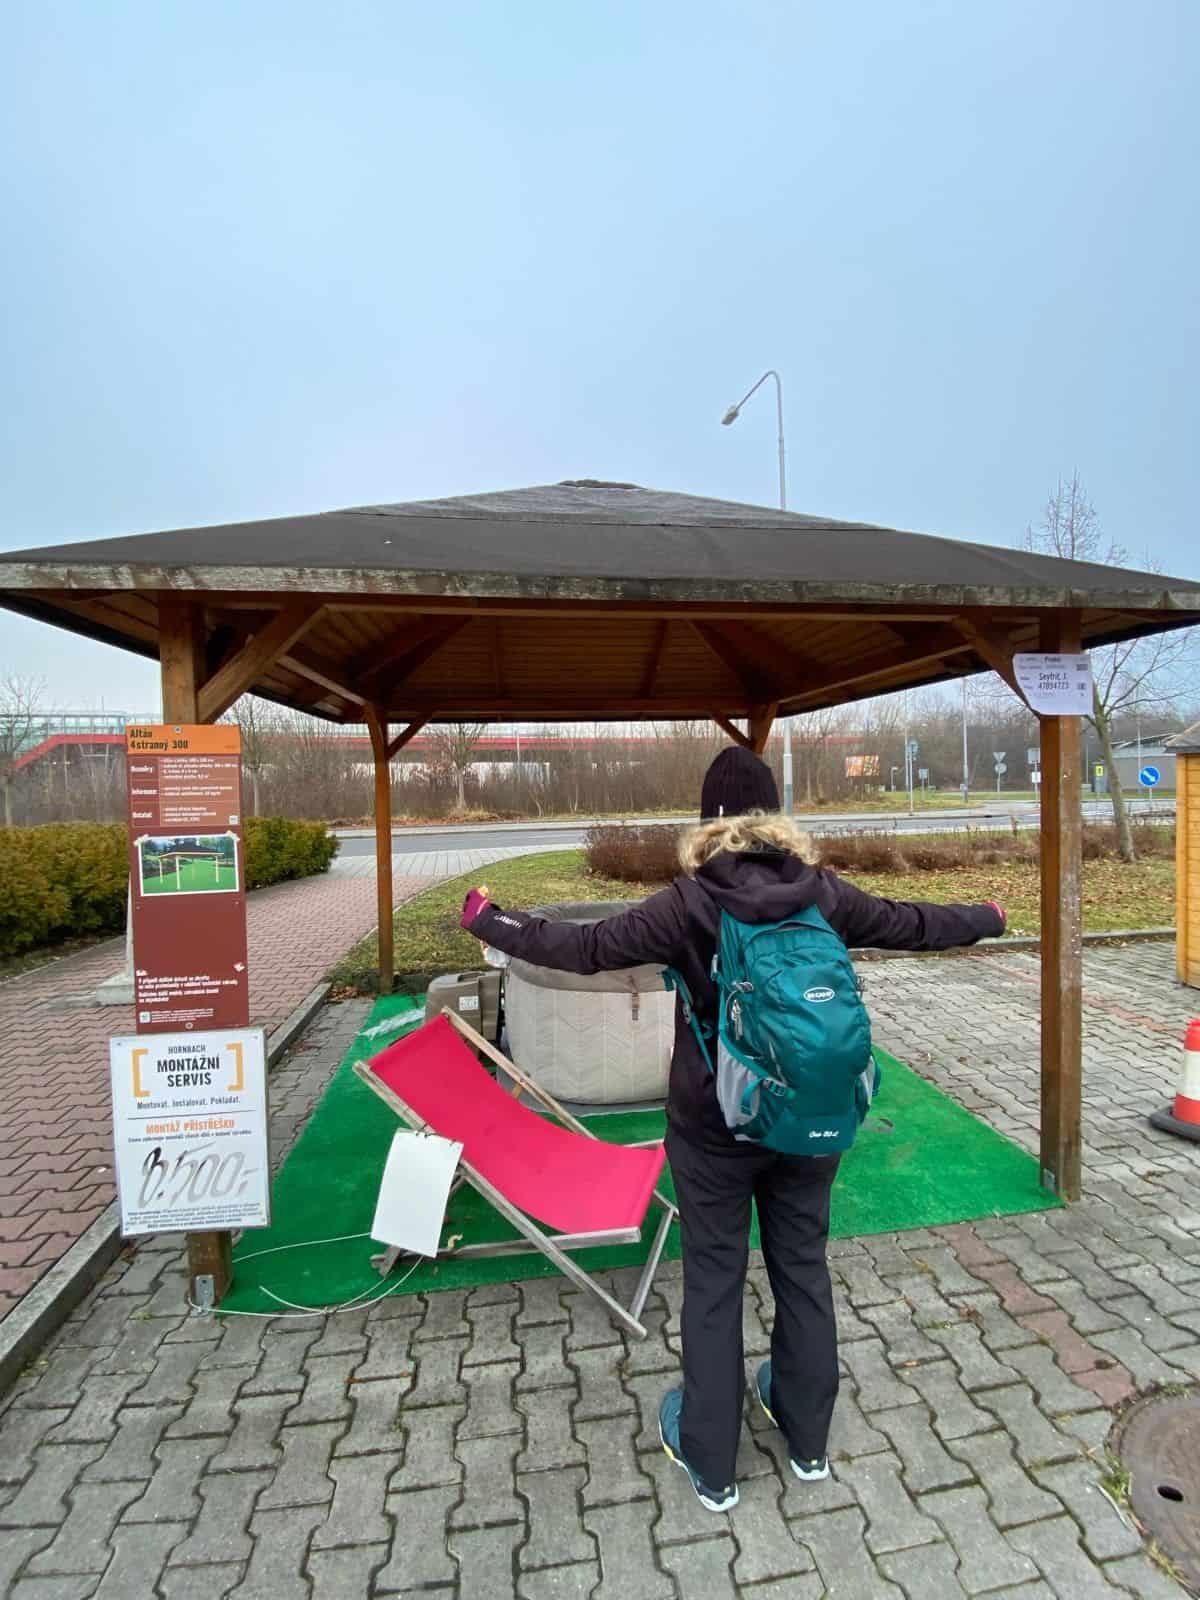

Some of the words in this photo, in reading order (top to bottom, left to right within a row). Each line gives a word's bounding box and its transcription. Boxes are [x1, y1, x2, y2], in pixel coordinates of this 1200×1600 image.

[130, 728, 152, 738] Altán
[168, 1044, 206, 1054] HORNBACH
[157, 1053, 220, 1073] MONTÁŽNÍ
[167, 1072, 212, 1088] SERVIS
